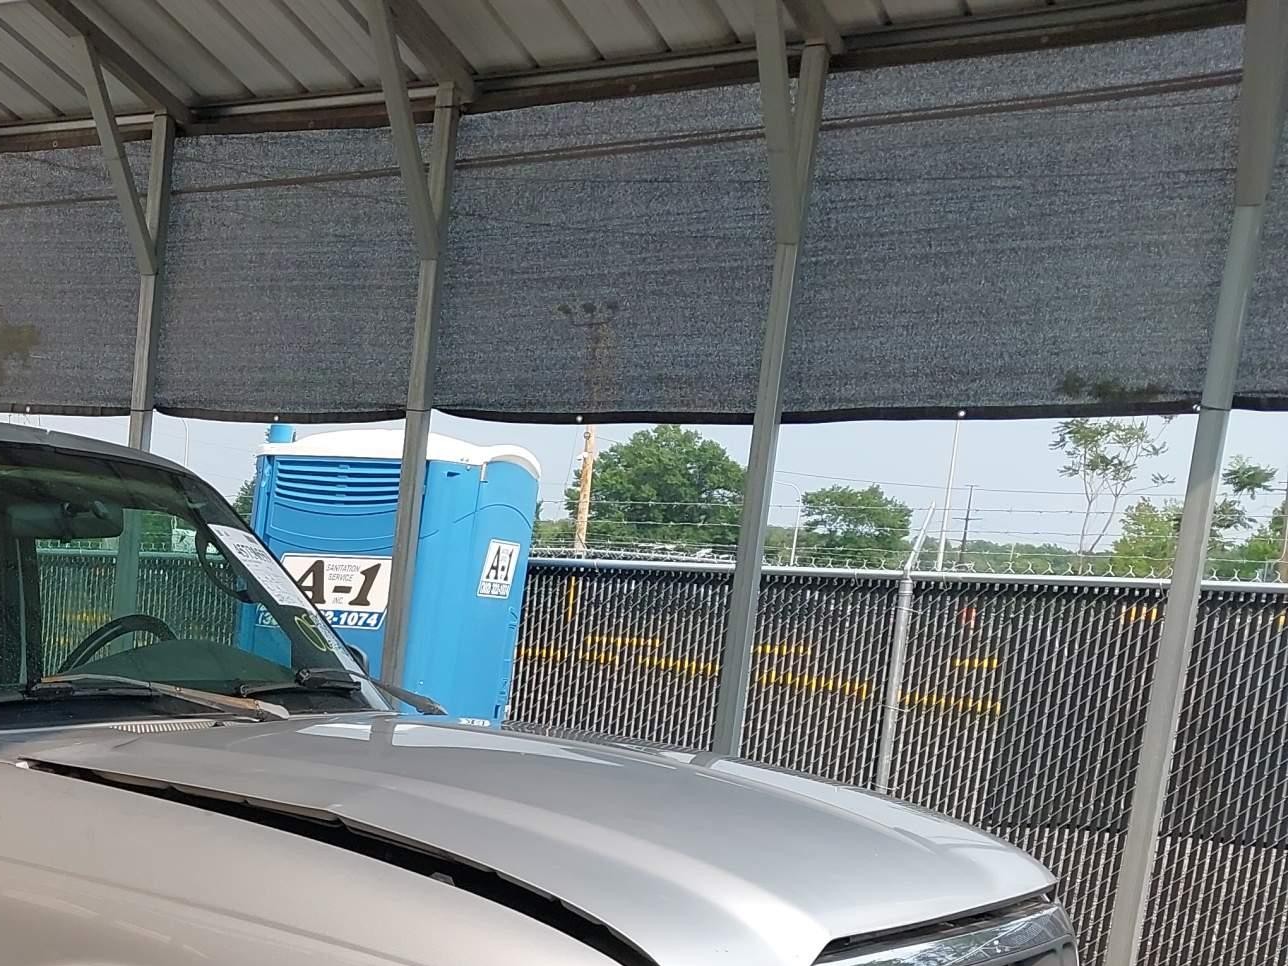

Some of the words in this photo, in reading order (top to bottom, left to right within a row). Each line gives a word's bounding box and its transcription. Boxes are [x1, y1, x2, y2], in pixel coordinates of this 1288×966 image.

[326, 563, 361, 573] SANITATION
[485, 545, 514, 582] A-1
[297, 559, 382, 606] A-1
[328, 573, 354, 582] SERVICE
